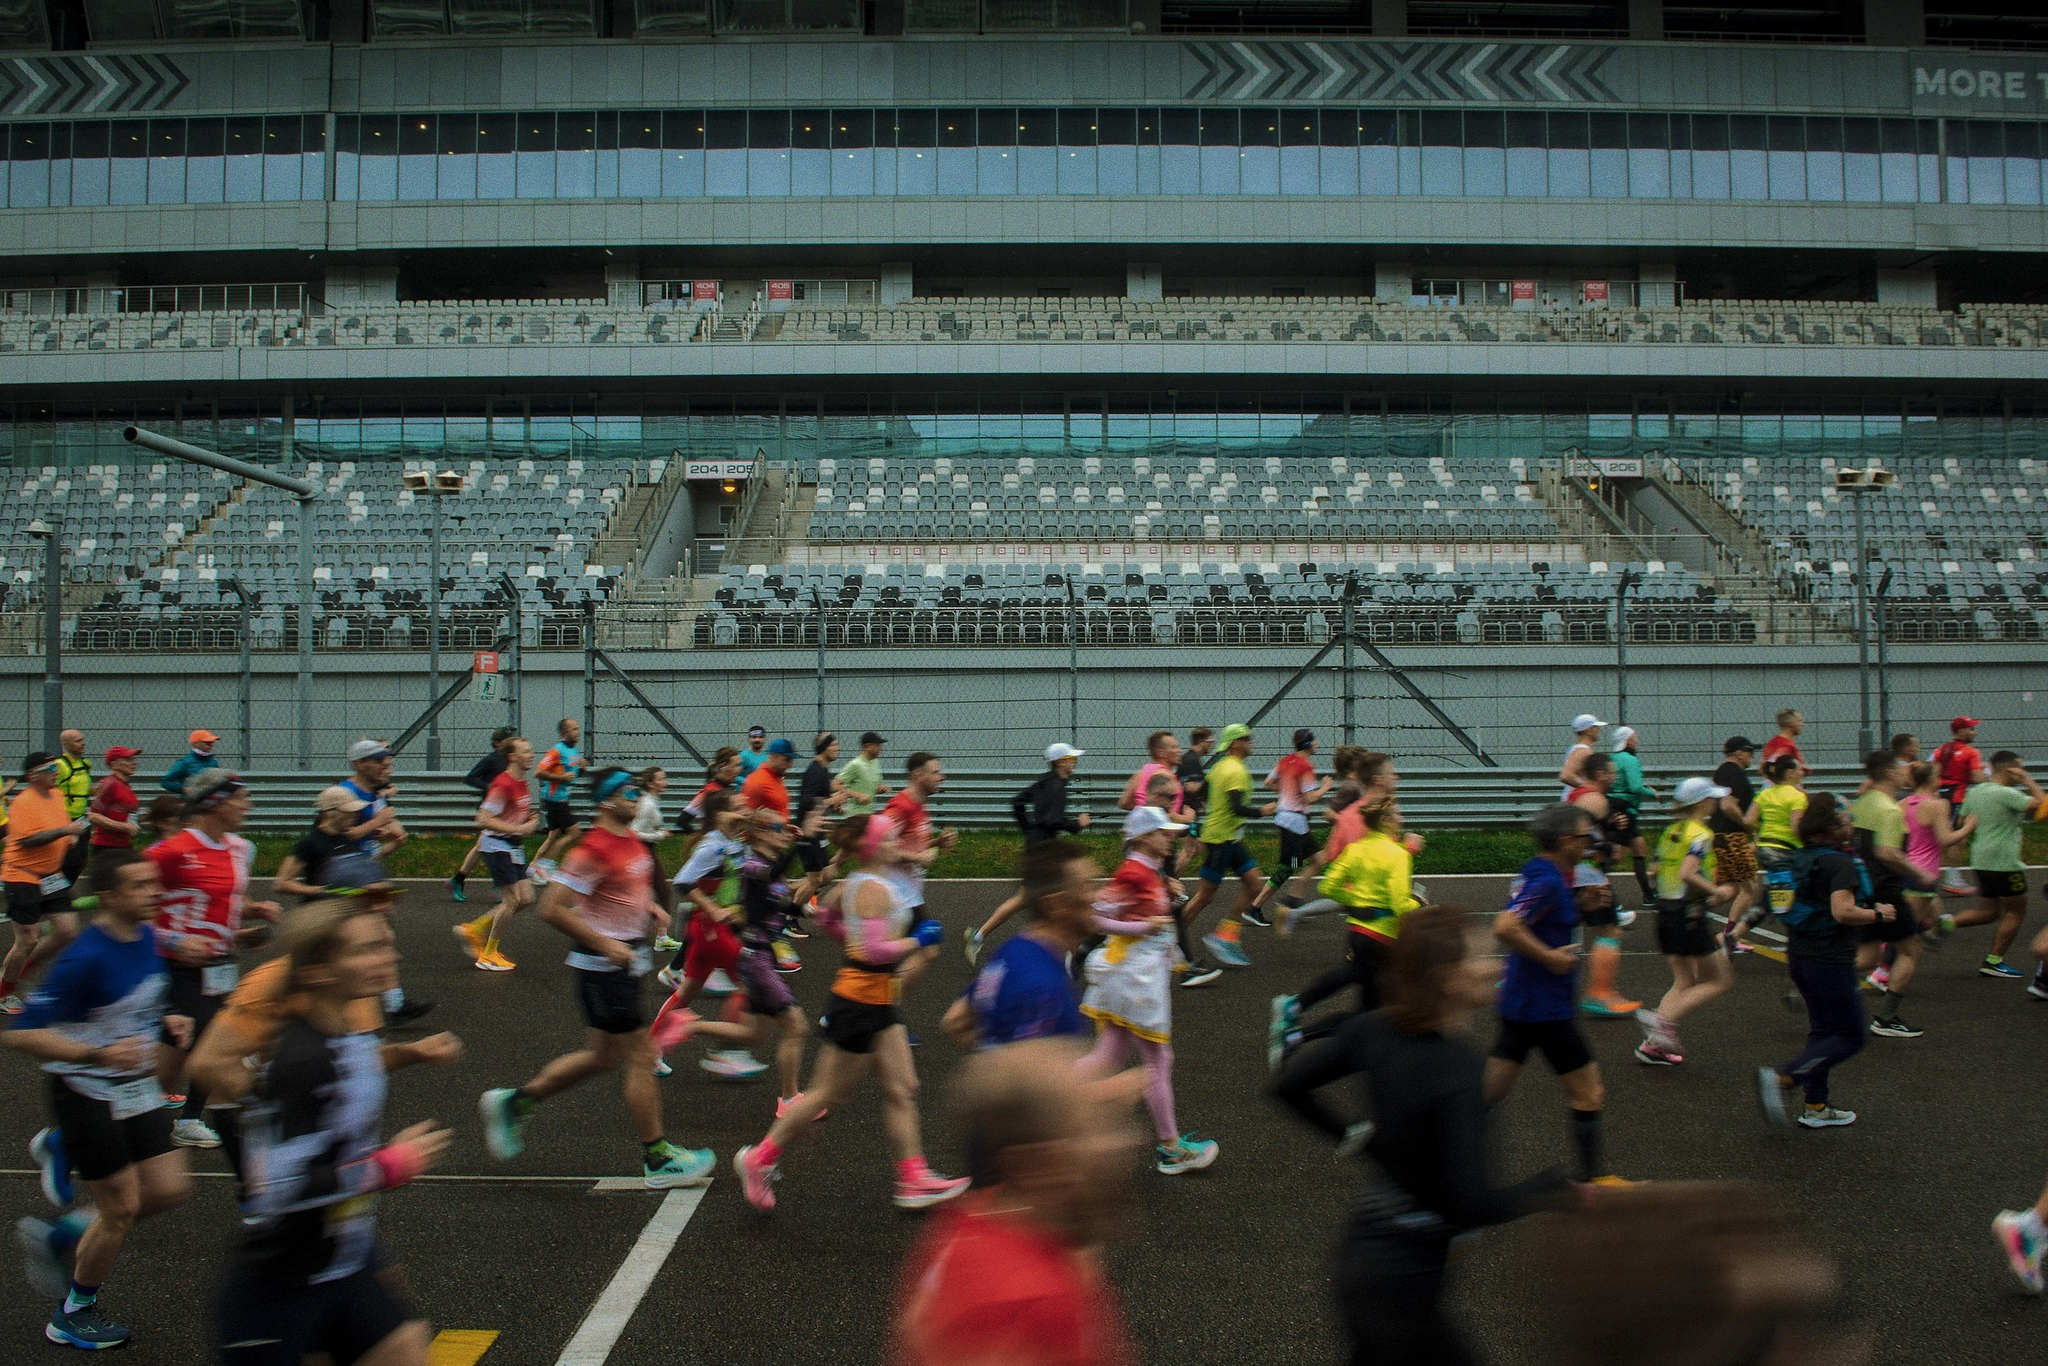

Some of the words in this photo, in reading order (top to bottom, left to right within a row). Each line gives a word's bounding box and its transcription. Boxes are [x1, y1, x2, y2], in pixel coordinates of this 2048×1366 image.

[1914, 67, 2027, 99] MORE
[690, 465, 719, 474] 204
[1609, 463, 1636, 472] 206
[481, 655, 494, 670] F
